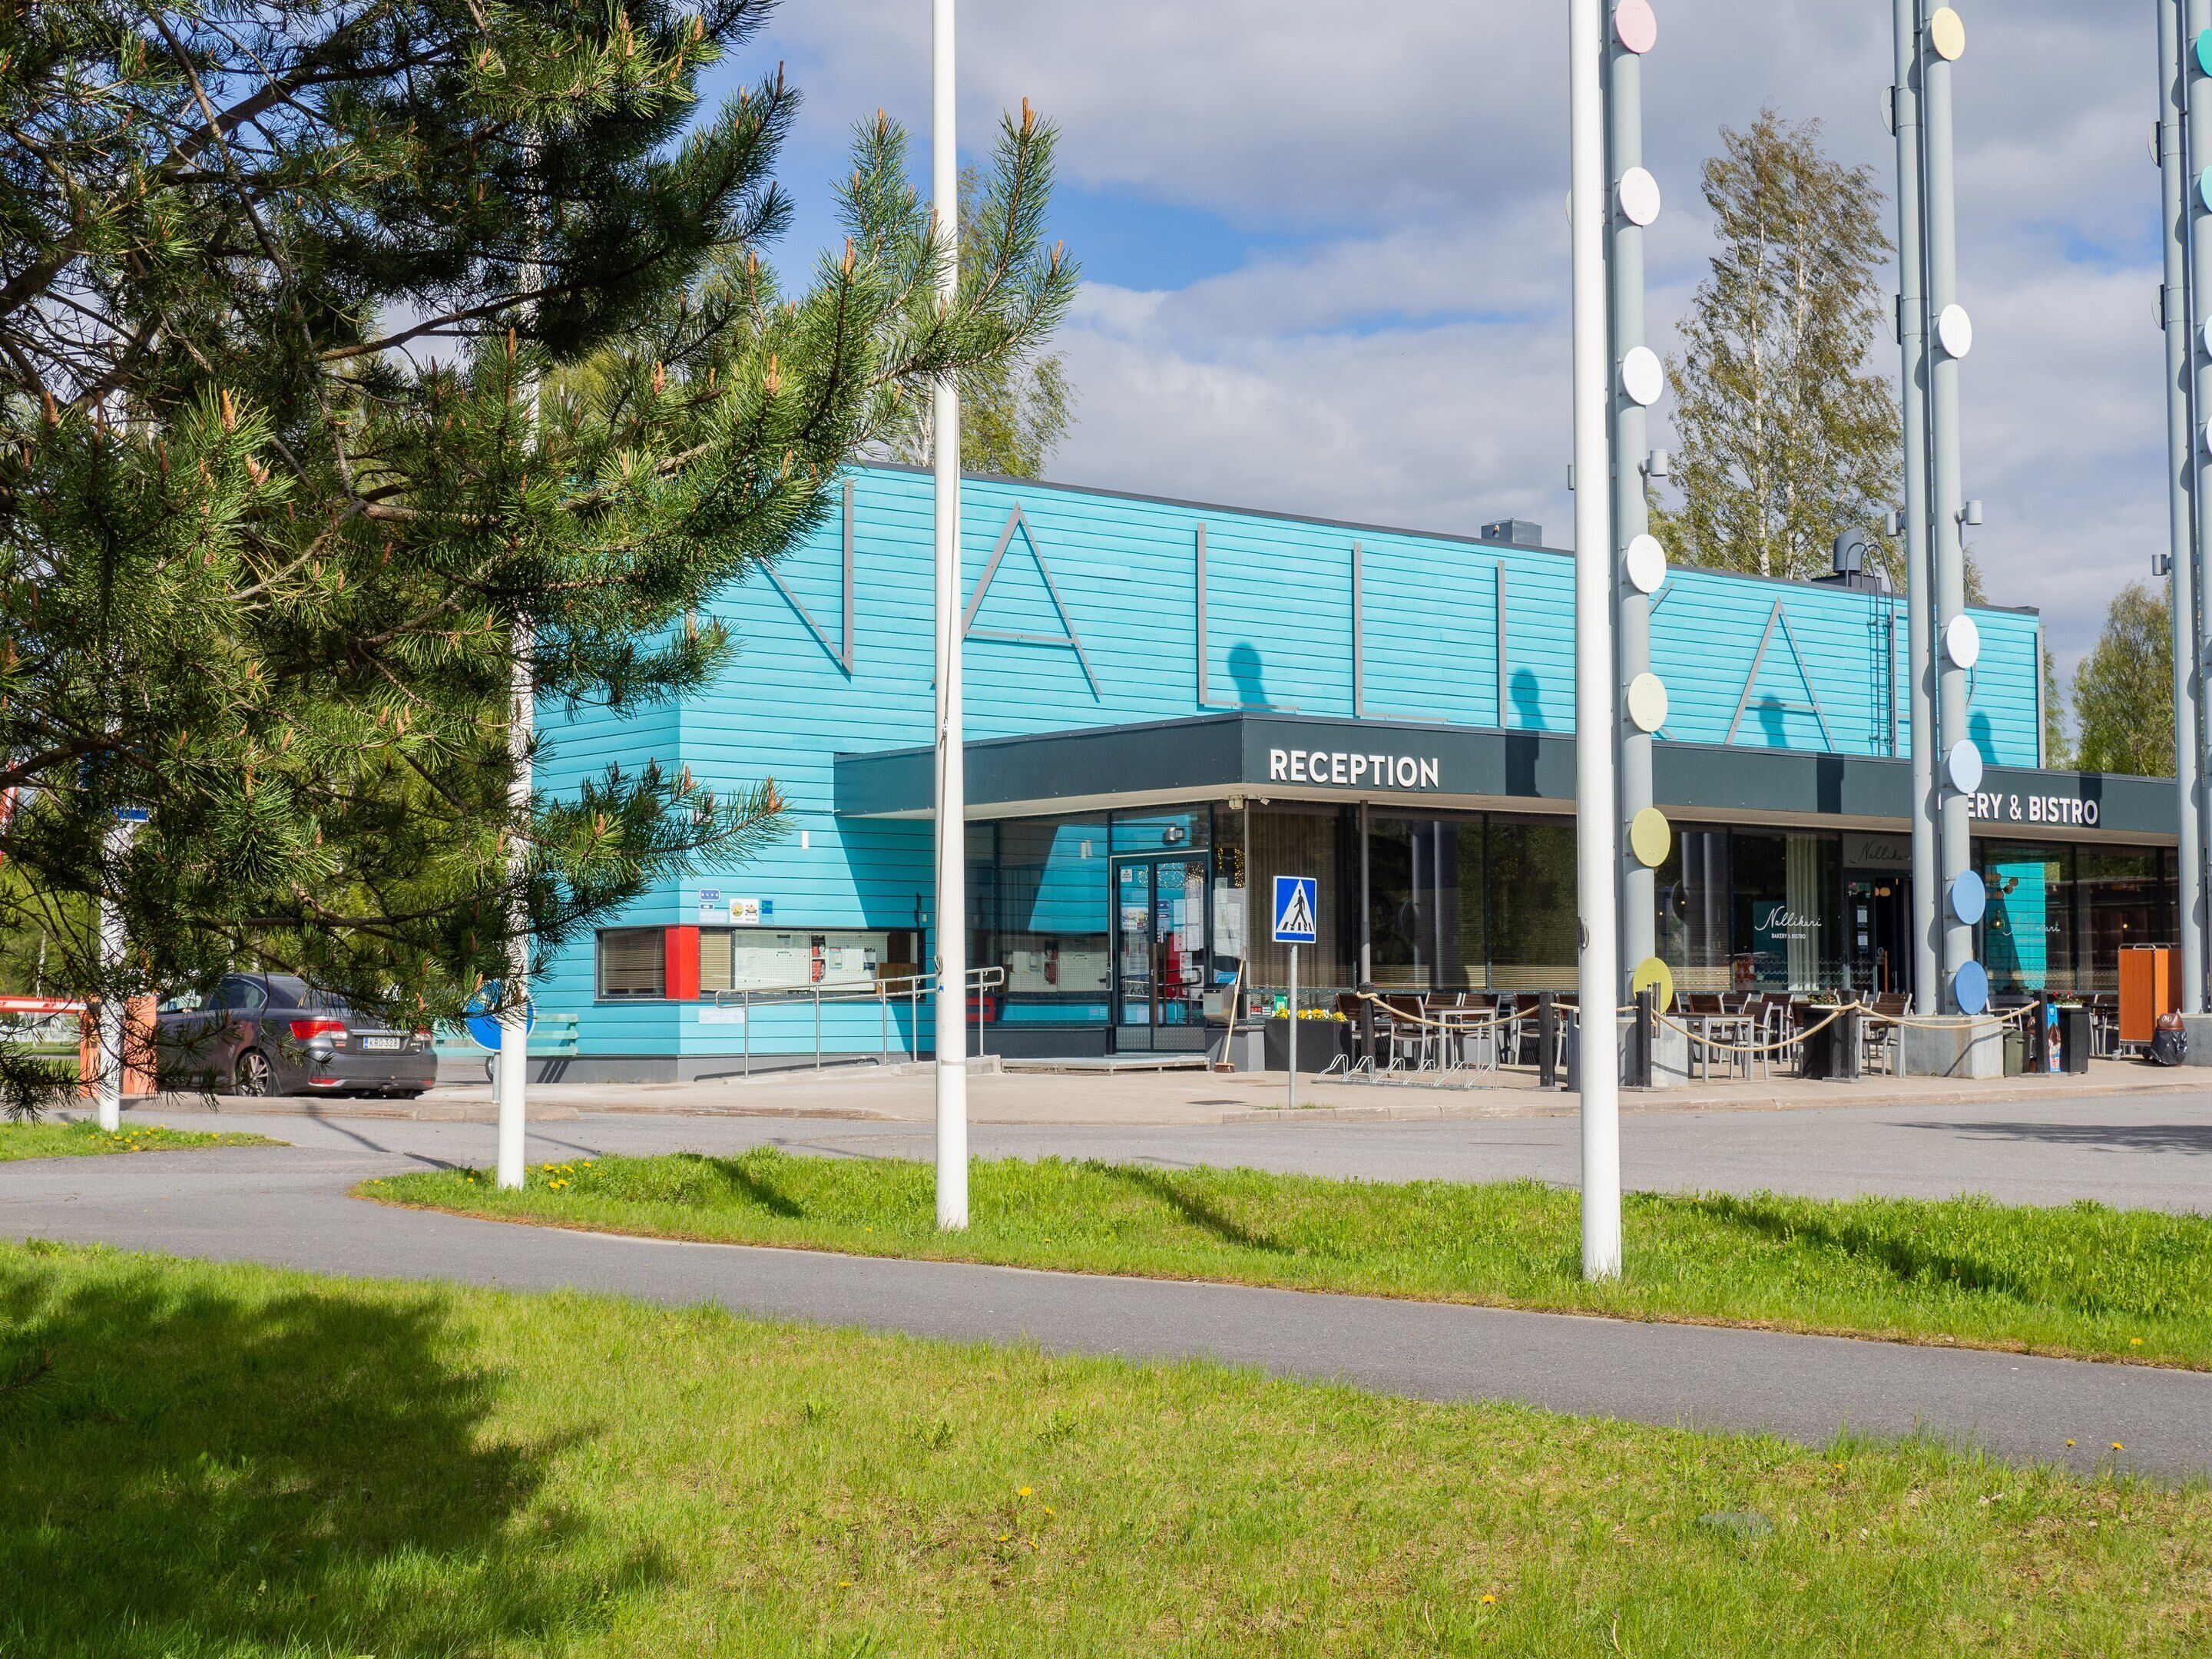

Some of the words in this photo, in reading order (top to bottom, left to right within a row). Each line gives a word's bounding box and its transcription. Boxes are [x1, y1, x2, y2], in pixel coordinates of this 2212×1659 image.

[1270, 749, 1439, 788] RECEPTION
[2009, 794, 2022, 820] &
[2028, 796, 2098, 826] BISTRO
[1754, 906, 1822, 931] Nallikari
